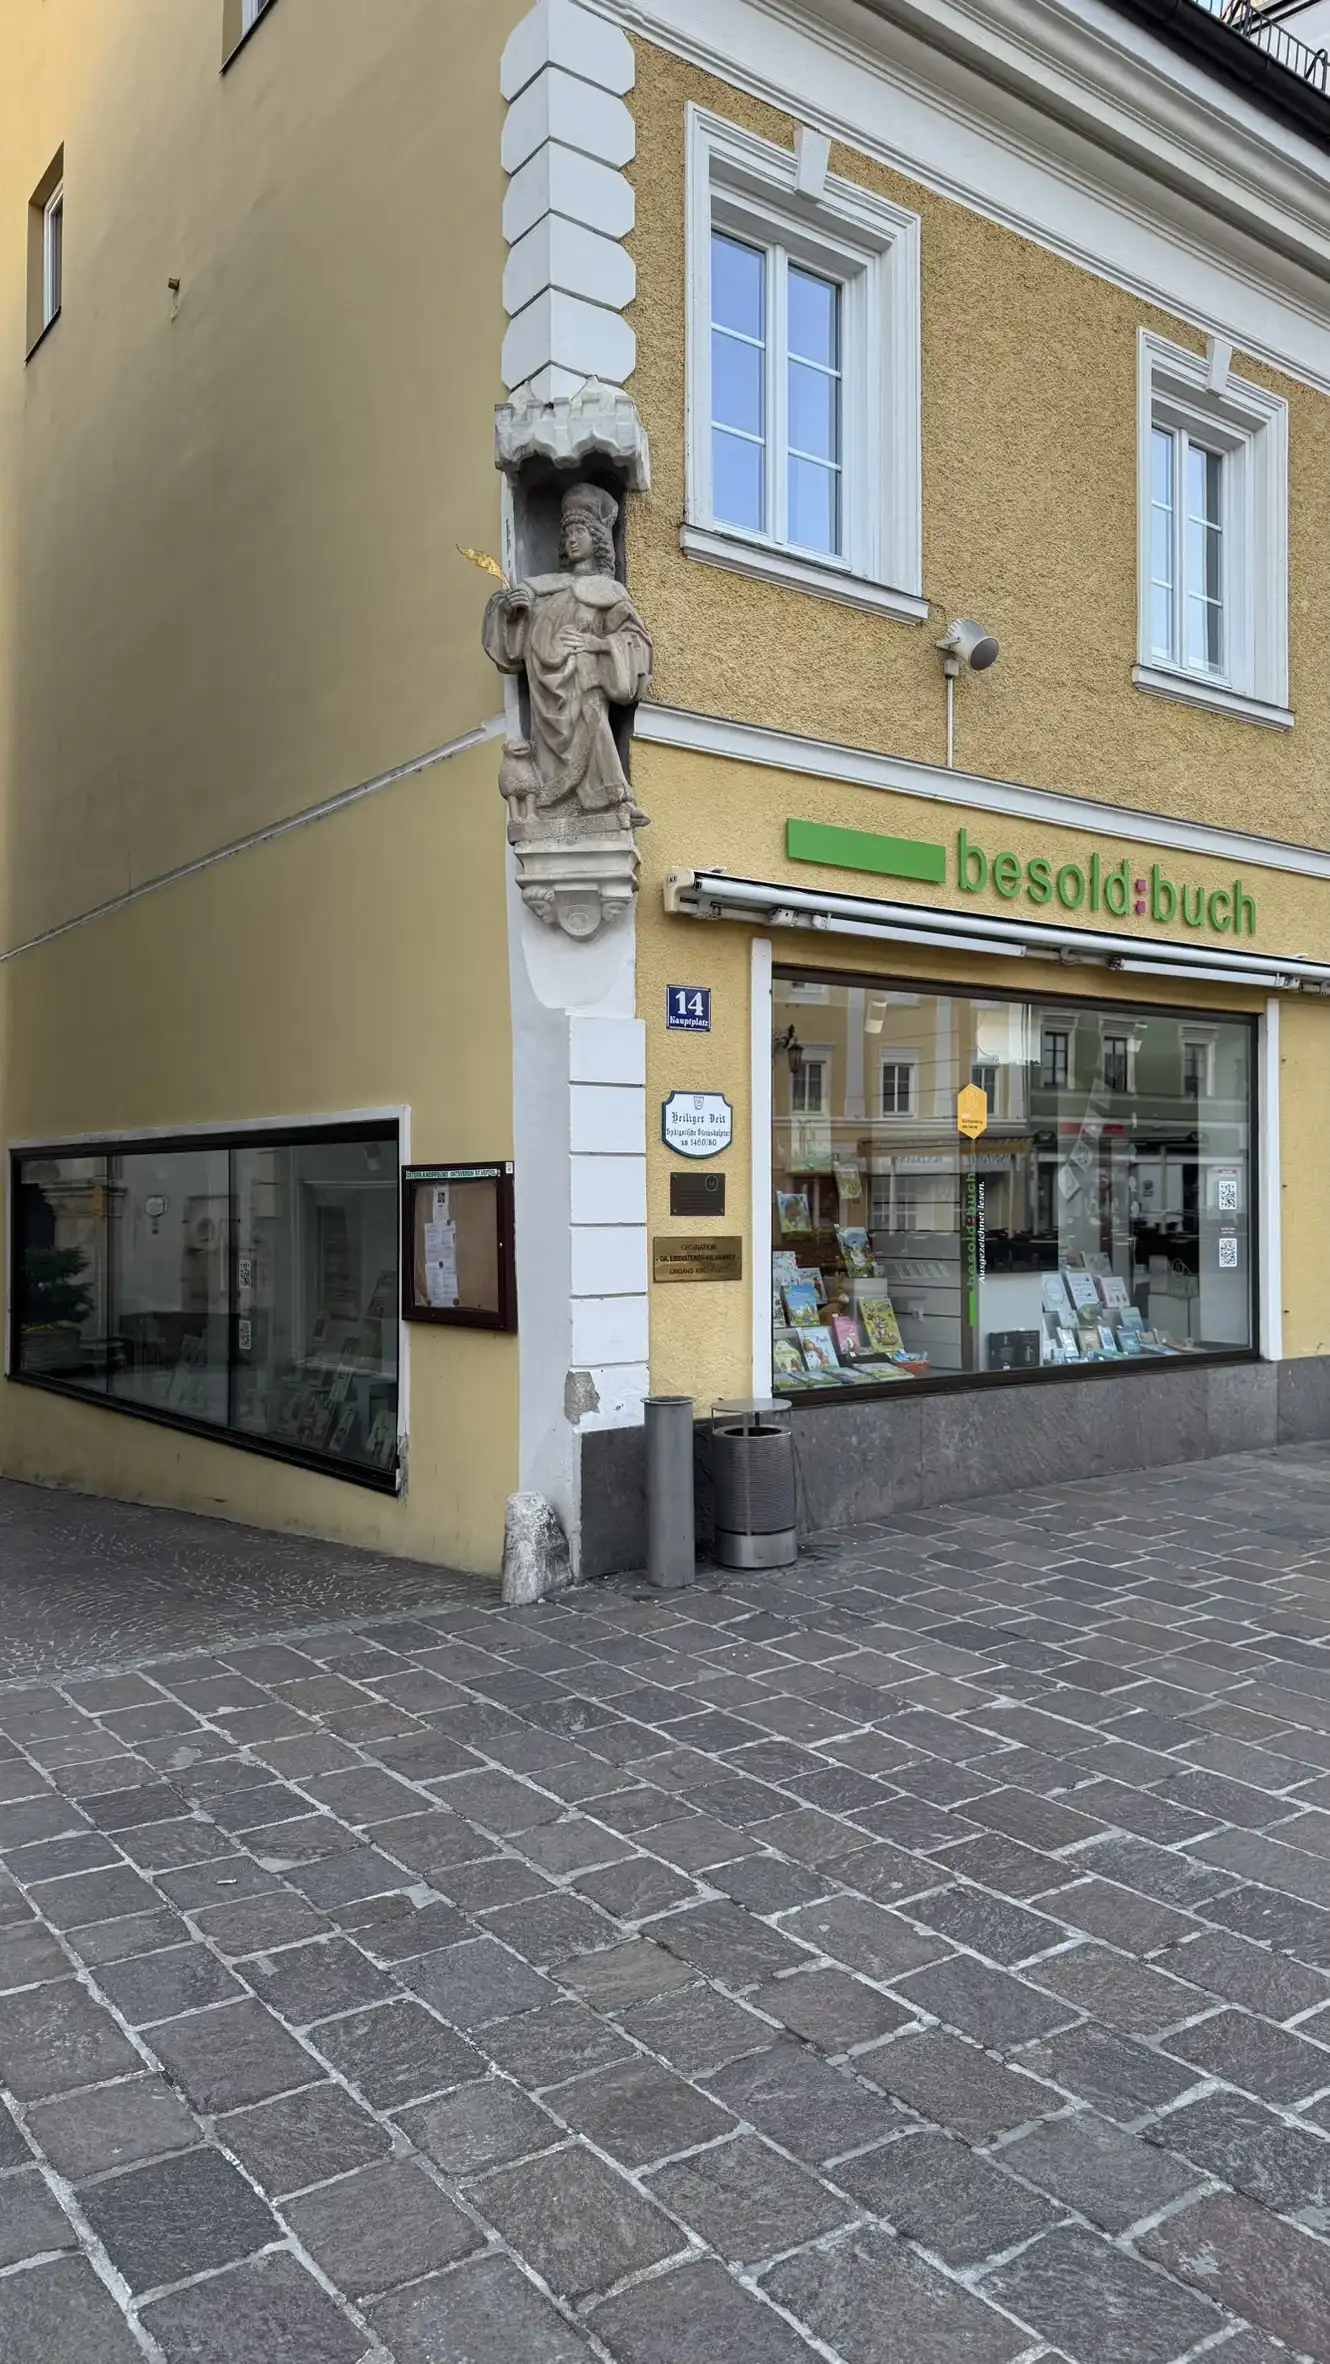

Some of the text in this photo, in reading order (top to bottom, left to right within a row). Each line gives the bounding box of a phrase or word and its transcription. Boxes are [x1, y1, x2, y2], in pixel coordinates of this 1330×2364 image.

[958, 827, 1256, 934] besold:buch
[670, 1015, 709, 1027] Hauptplatz
[675, 991, 704, 1016] 14
[977, 1181, 987, 1286] Ausgezeichnet lesen.
